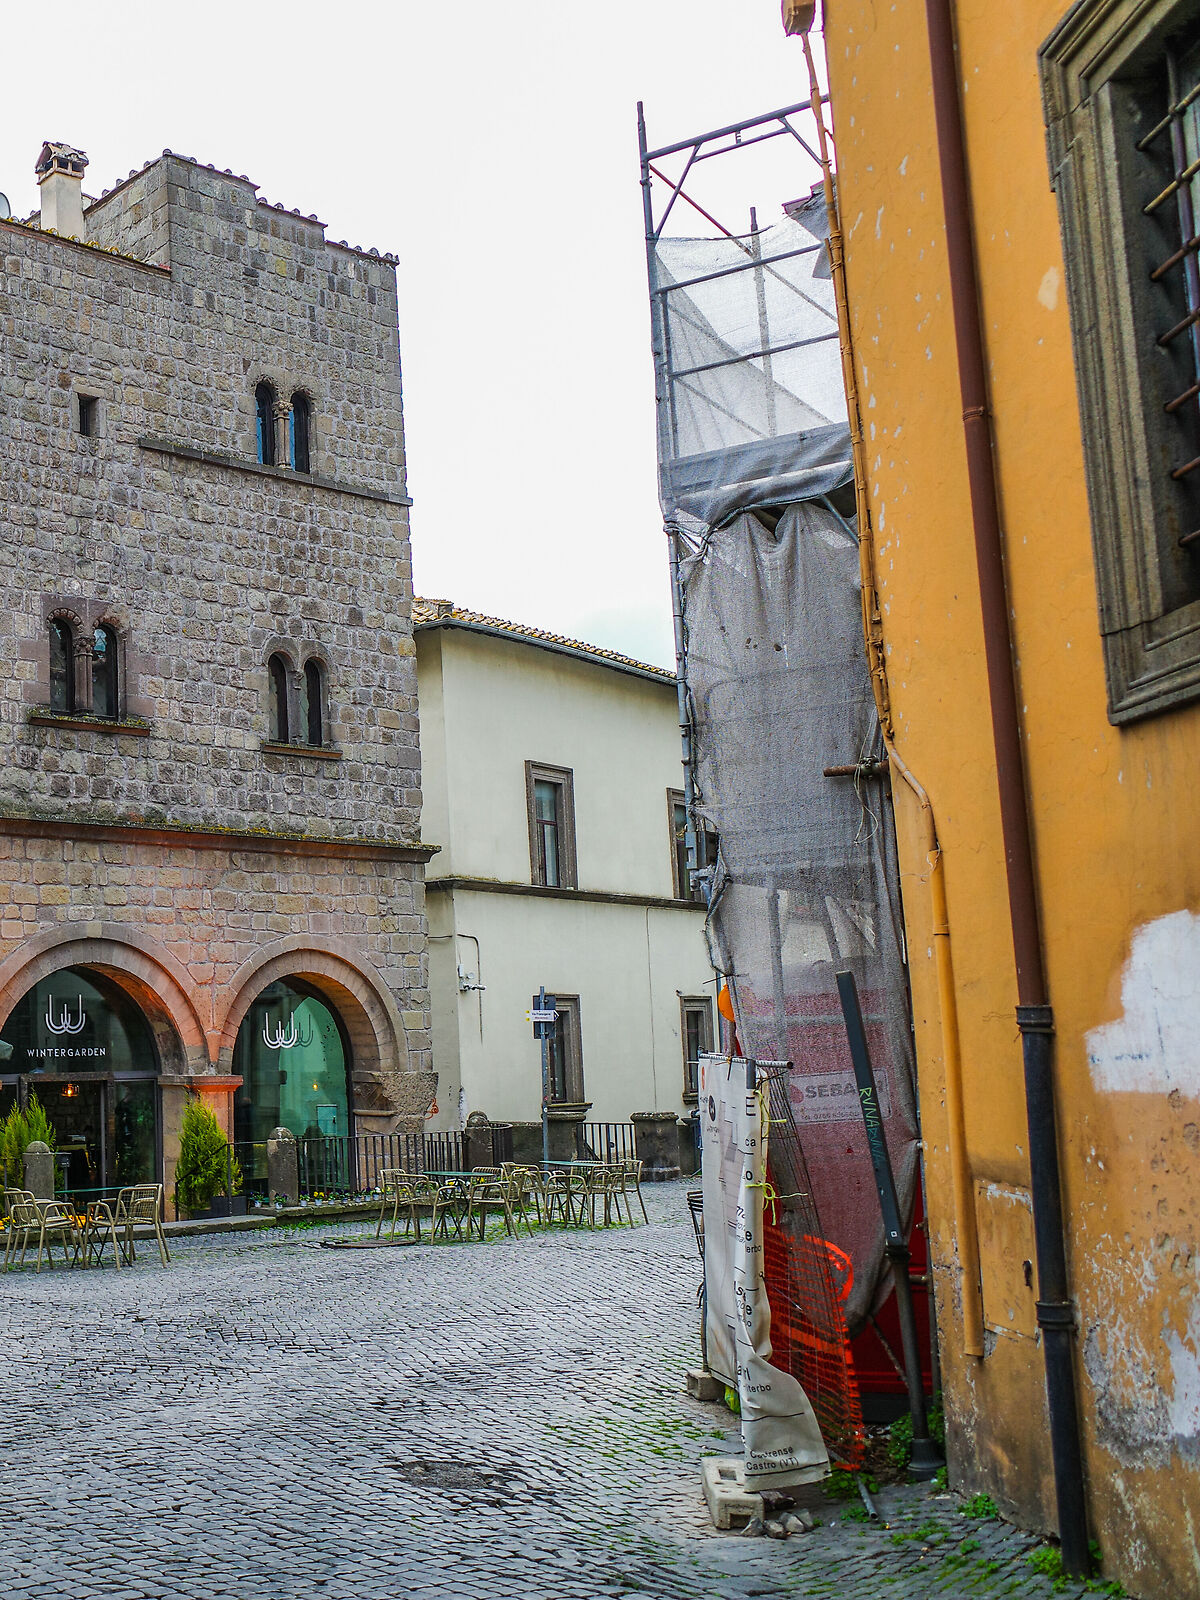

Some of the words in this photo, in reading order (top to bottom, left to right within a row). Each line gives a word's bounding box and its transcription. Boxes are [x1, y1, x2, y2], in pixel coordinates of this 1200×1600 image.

[26, 1047, 107, 1058] WINTERGARDEN
[805, 1082, 884, 1099] SEBA
[746, 1461, 777, 1471] Castro
